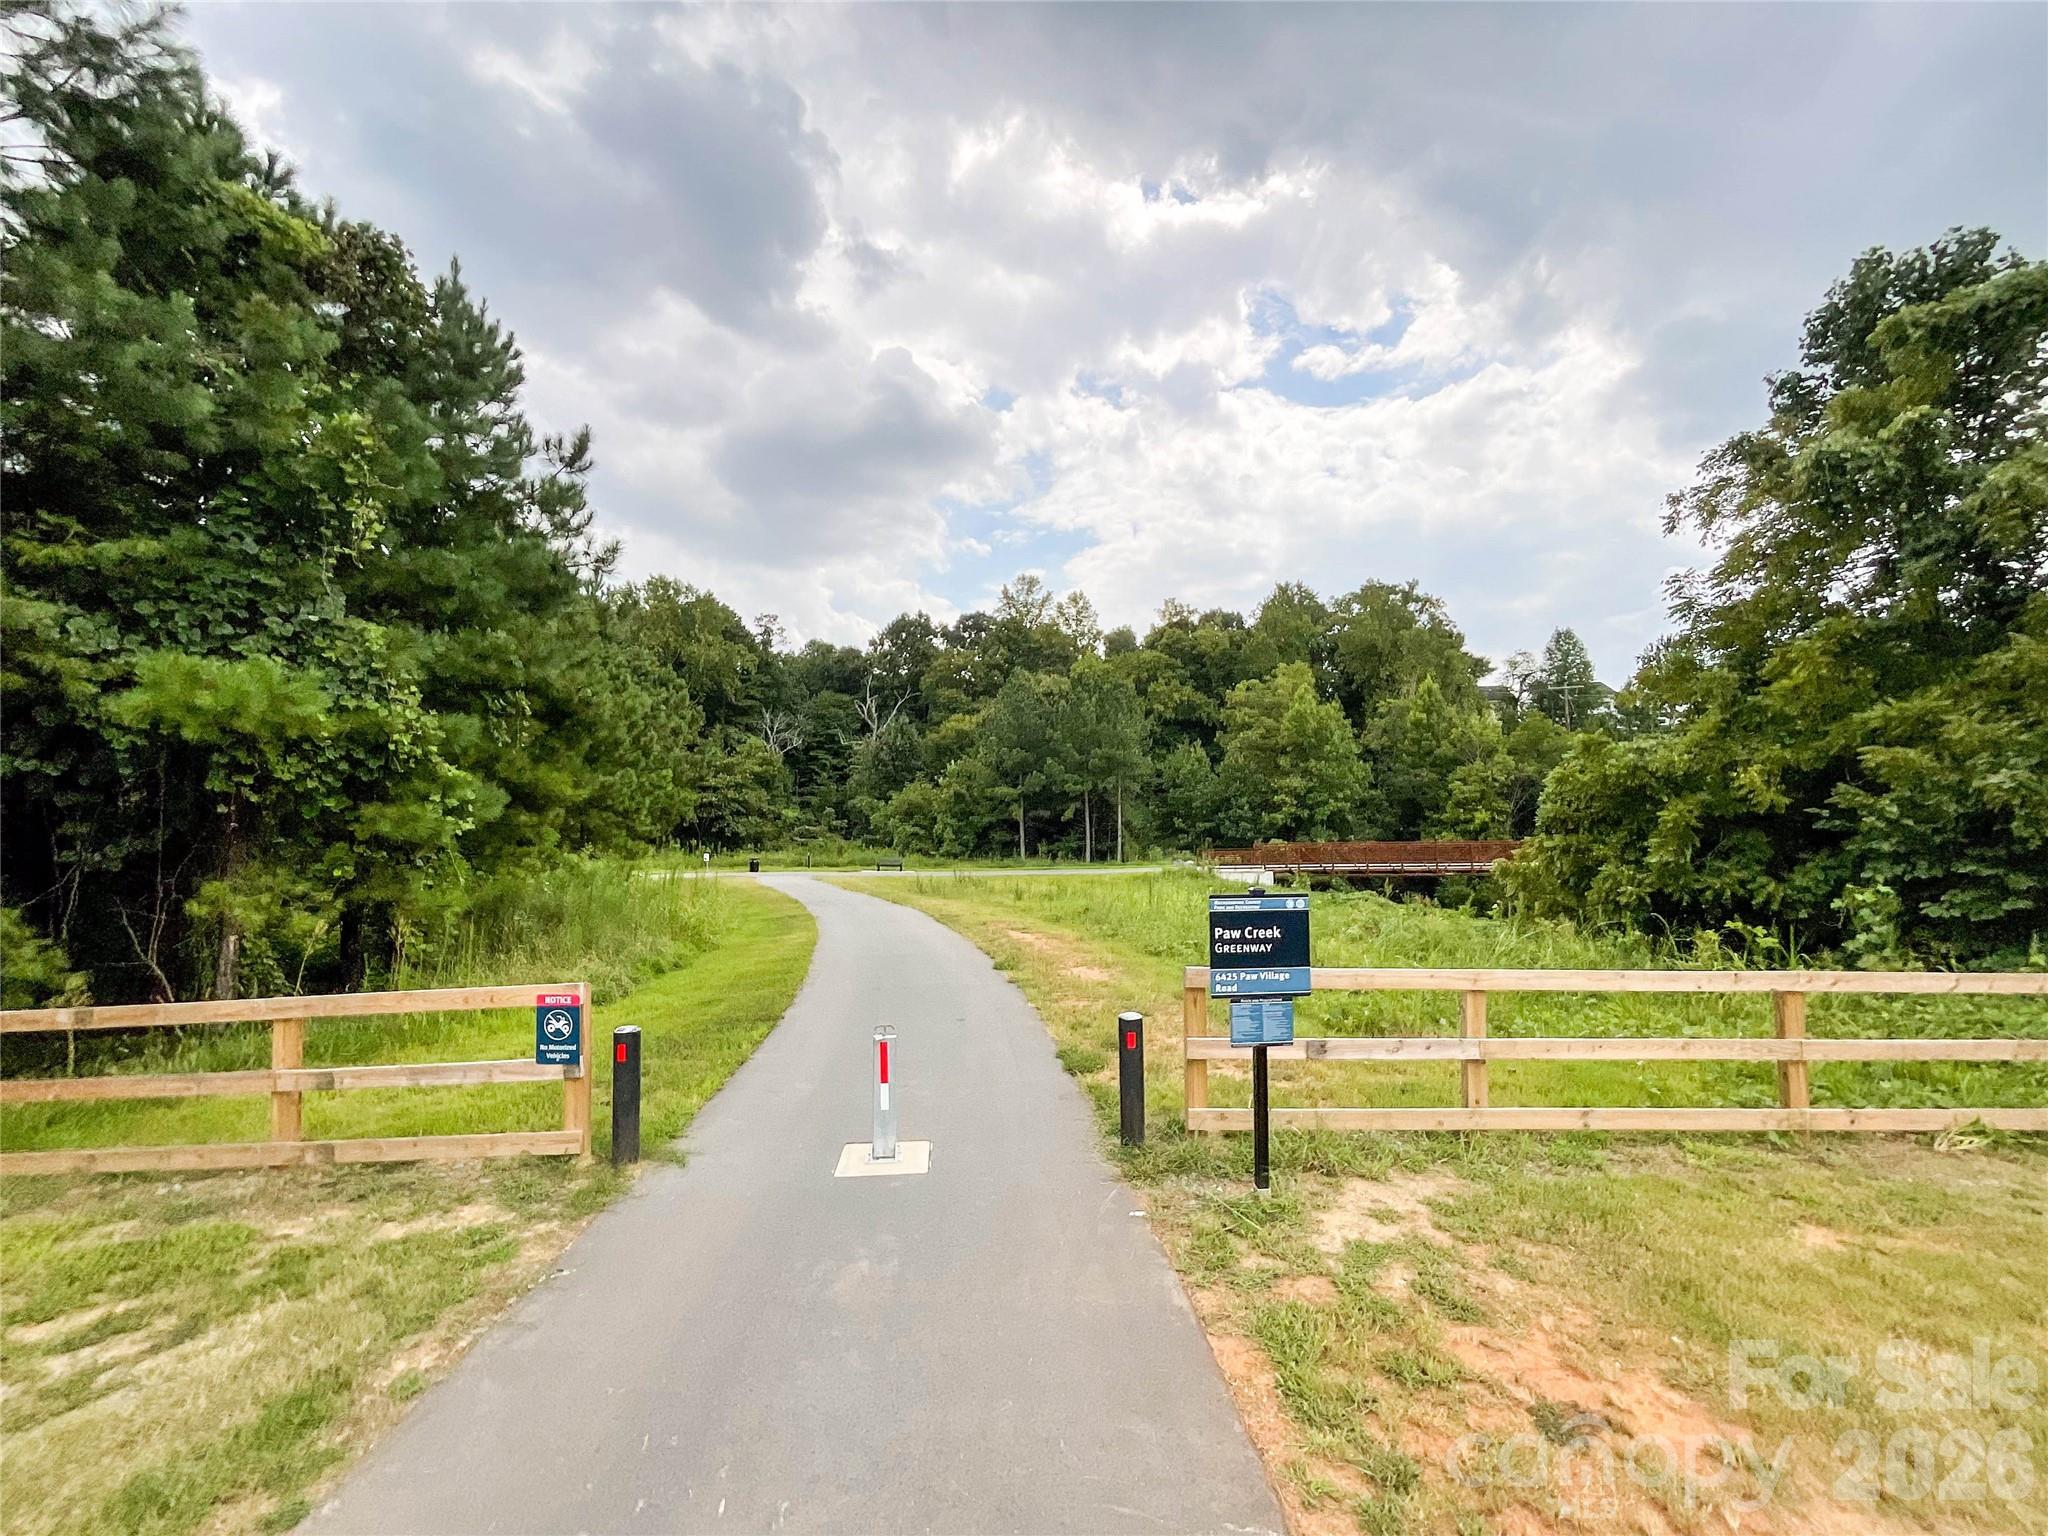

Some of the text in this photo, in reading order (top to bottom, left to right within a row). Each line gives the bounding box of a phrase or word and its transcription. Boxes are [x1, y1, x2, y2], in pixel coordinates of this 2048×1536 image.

[1214, 926, 1281, 939] Paw Creek
[1215, 942, 1273, 953] GREENWAY
[1215, 971, 1290, 982] 6425 Paw Village
[1215, 983, 1238, 992] Road
[544, 996, 572, 1004] NOTICE
